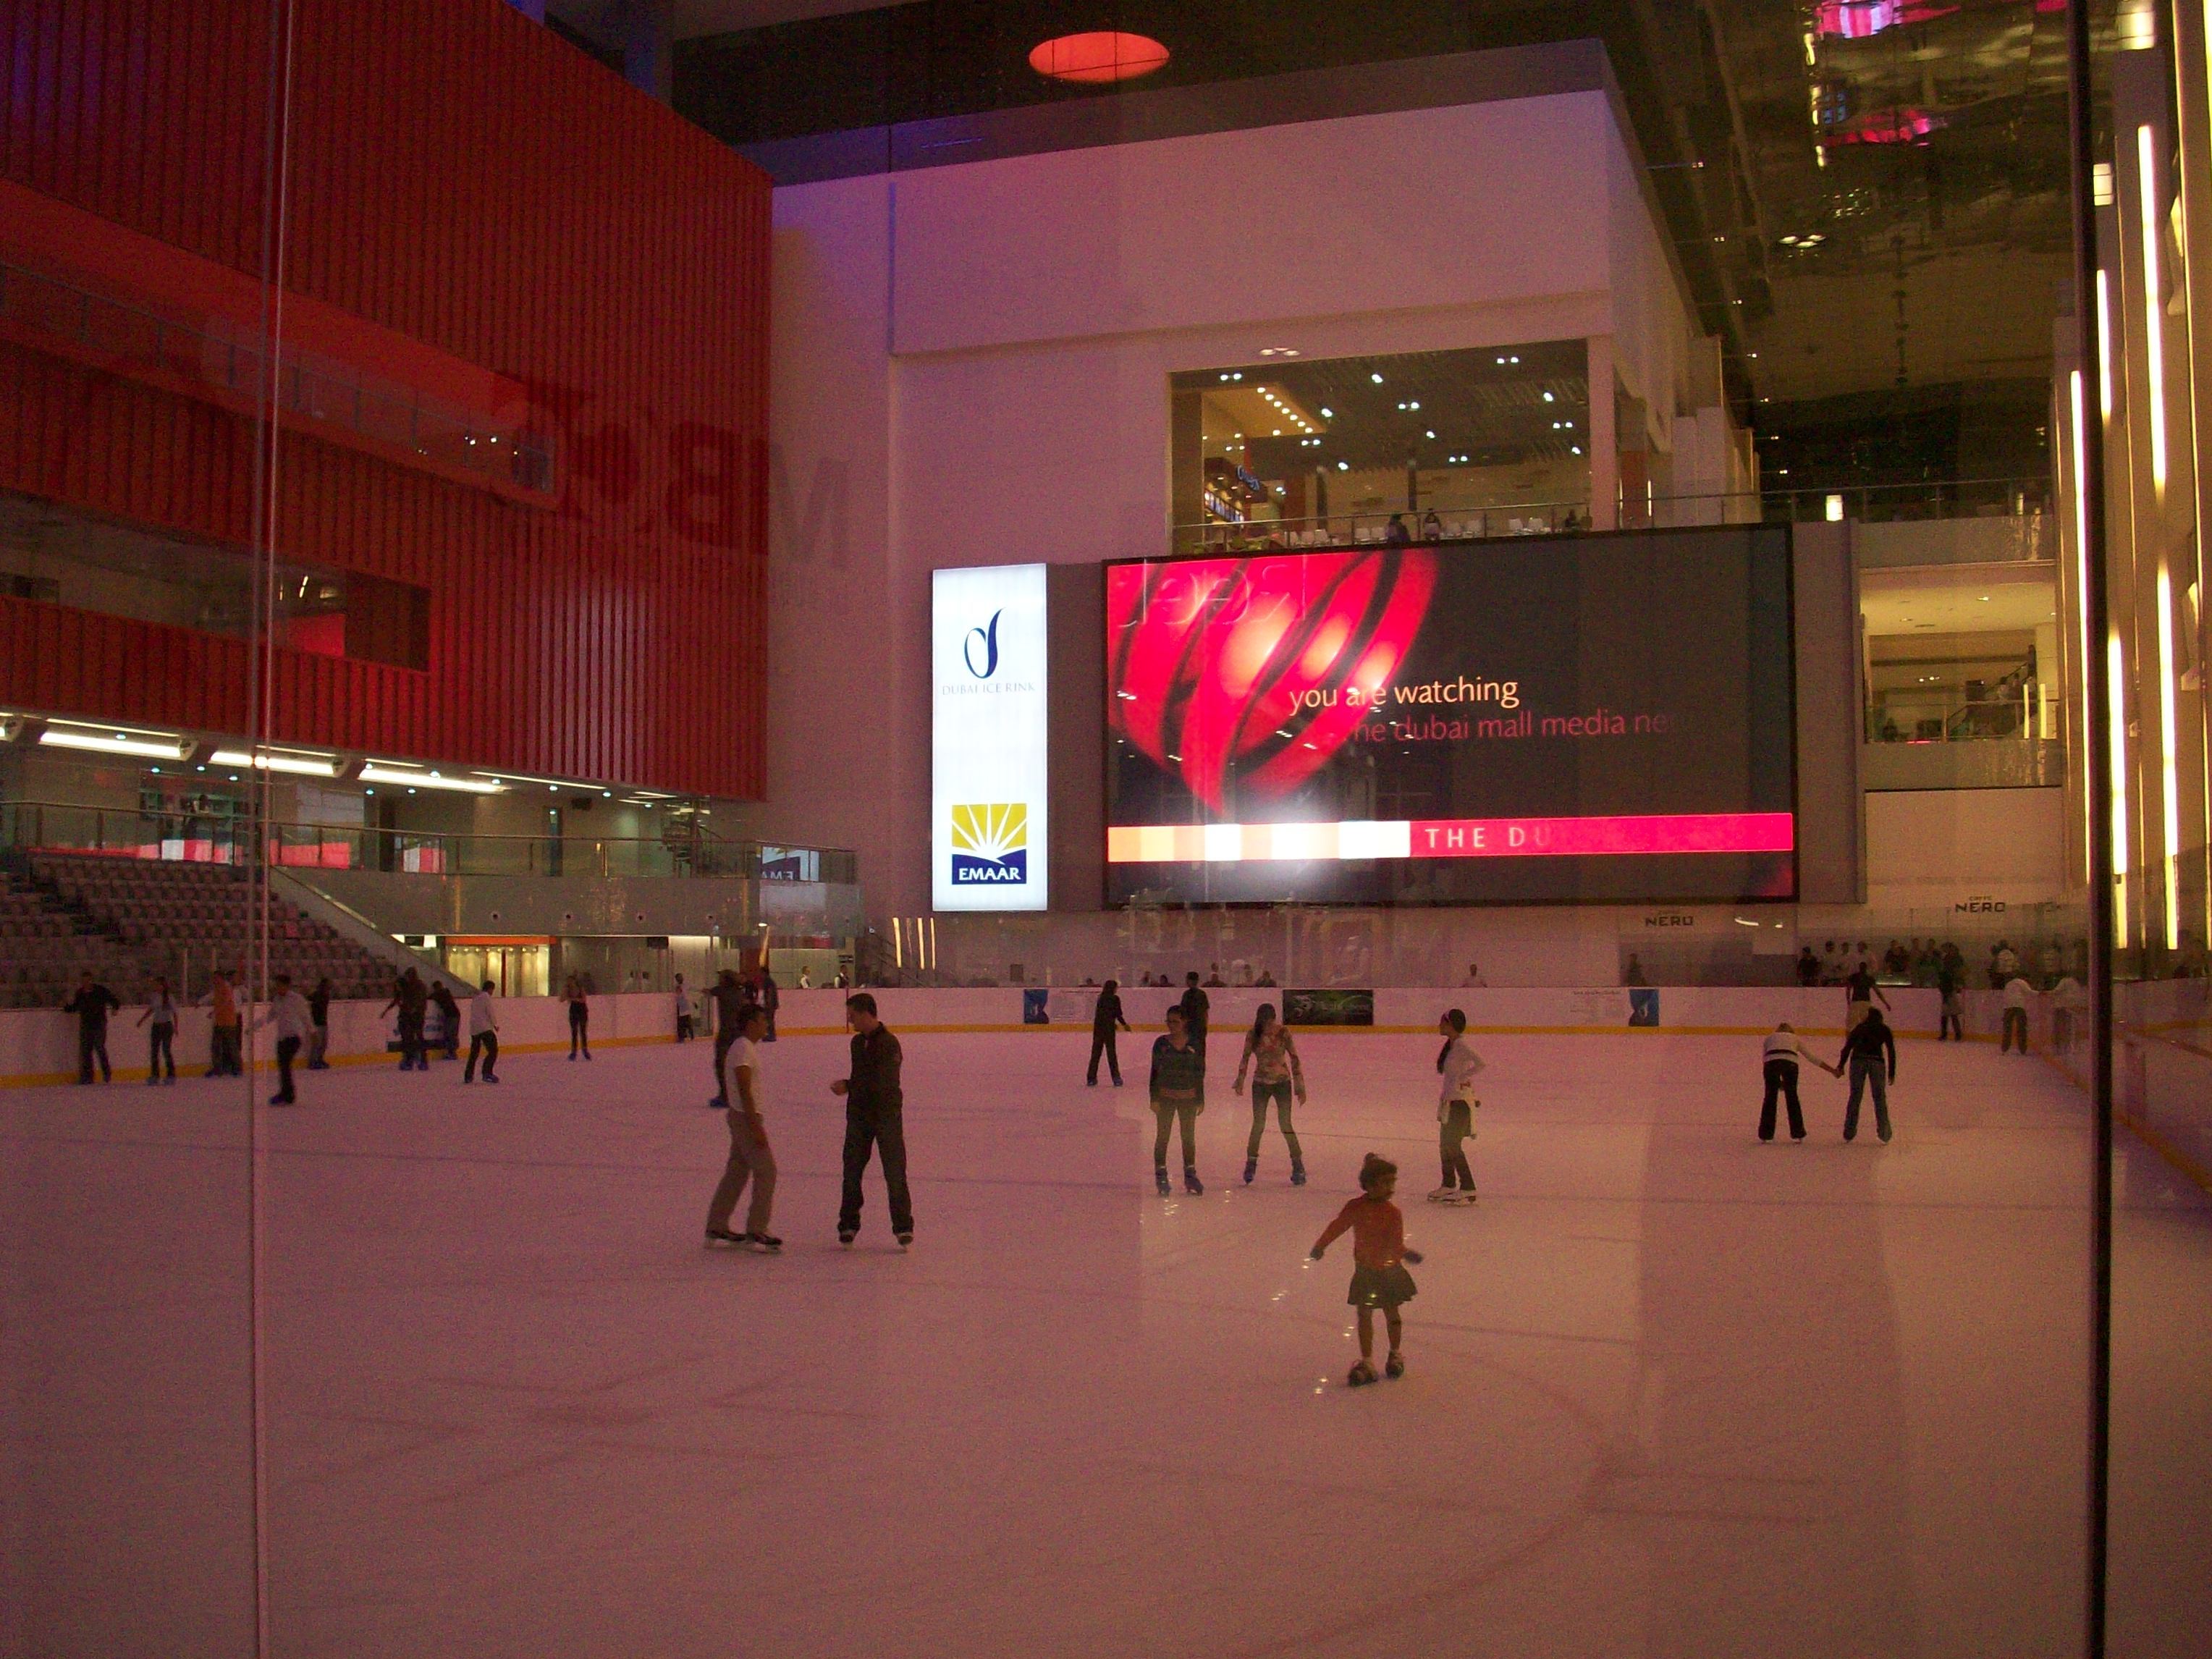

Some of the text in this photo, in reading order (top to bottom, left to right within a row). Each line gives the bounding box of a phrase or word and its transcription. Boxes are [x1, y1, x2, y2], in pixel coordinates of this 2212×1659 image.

[942, 682, 1035, 695] DUBAI ICE RINK
[1289, 676, 1520, 716] you are watching
[1394, 712, 1469, 741] dubai
[1477, 710, 1532, 738] mall
[1541, 709, 1626, 736] media
[1424, 827, 1485, 848] THE
[958, 867, 1021, 880] EMAAR
[1955, 902, 2006, 913] NERO
[1645, 916, 1694, 926] NERO
